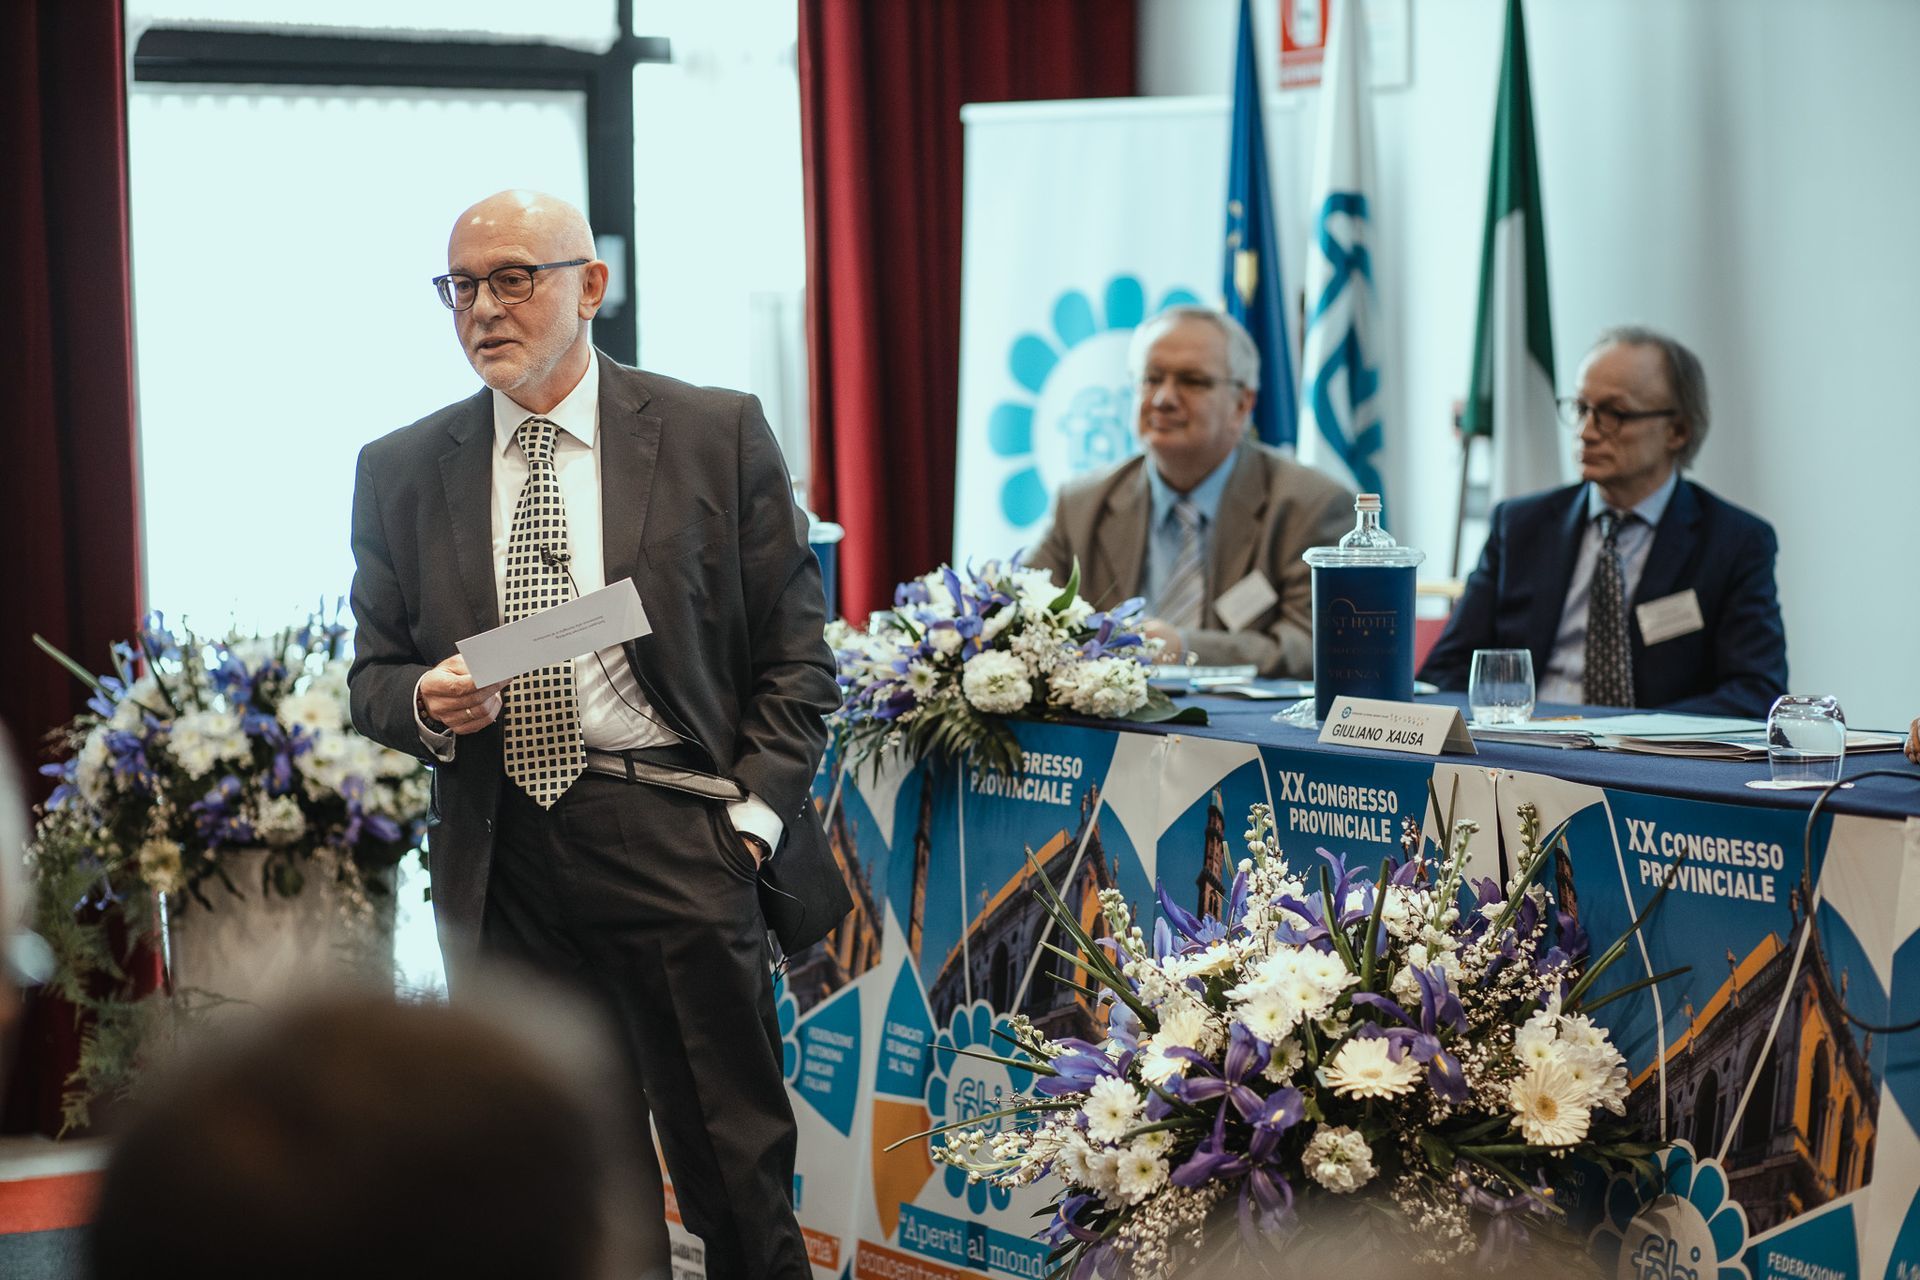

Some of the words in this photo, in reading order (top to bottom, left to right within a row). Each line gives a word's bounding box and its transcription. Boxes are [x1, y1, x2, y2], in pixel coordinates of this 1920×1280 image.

[1332, 723, 1383, 741] GIULIANO
[1385, 729, 1425, 746] XAUSA
[970, 771, 1073, 806] PROVINCIALE
[1279, 770, 1306, 803] XX
[1308, 781, 1398, 815] CONGRESSO
[1289, 807, 1392, 844] PROVINCIALE
[1625, 817, 1659, 856] XX
[1660, 831, 1784, 870] CONGRESSO
[1639, 859, 1776, 903] PROVINCIALE
[857, 1249, 959, 1280] concent
[967, 1235, 985, 1261] al
[1767, 1252, 1846, 1280] FEDERAZIONE
